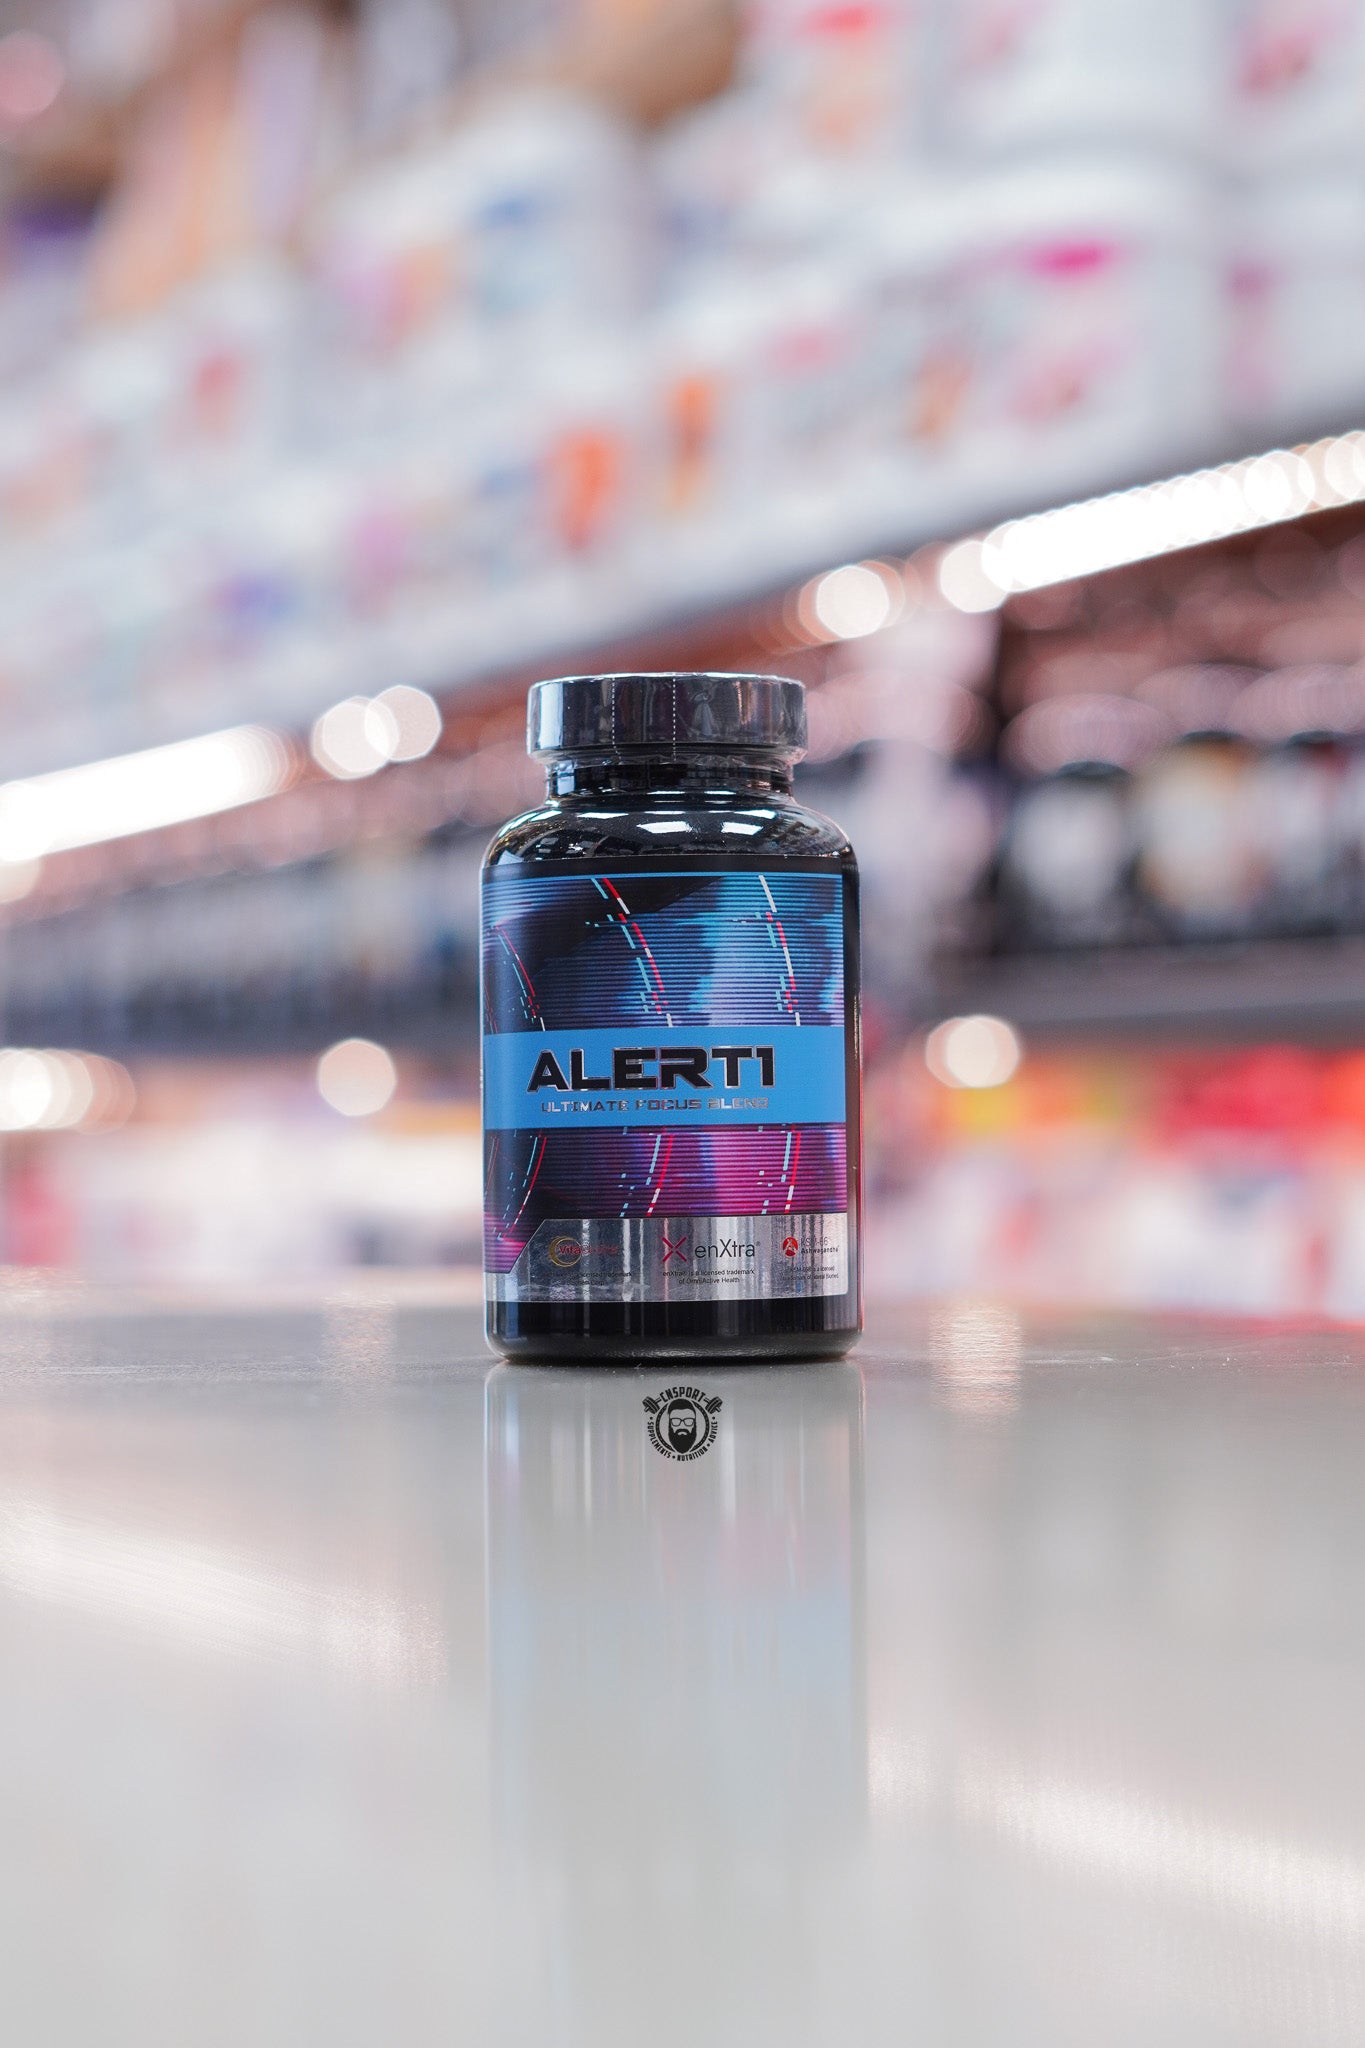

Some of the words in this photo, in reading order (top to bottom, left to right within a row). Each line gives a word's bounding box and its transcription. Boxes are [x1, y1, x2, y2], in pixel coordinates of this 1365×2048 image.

[527, 1045, 776, 1093] ALERT1
[541, 1100, 629, 1113] ULTIMATE
[635, 1099, 702, 1111] FOCUS
[707, 1097, 769, 1110] BLEND
[726, 1268, 755, 1276] trademark
